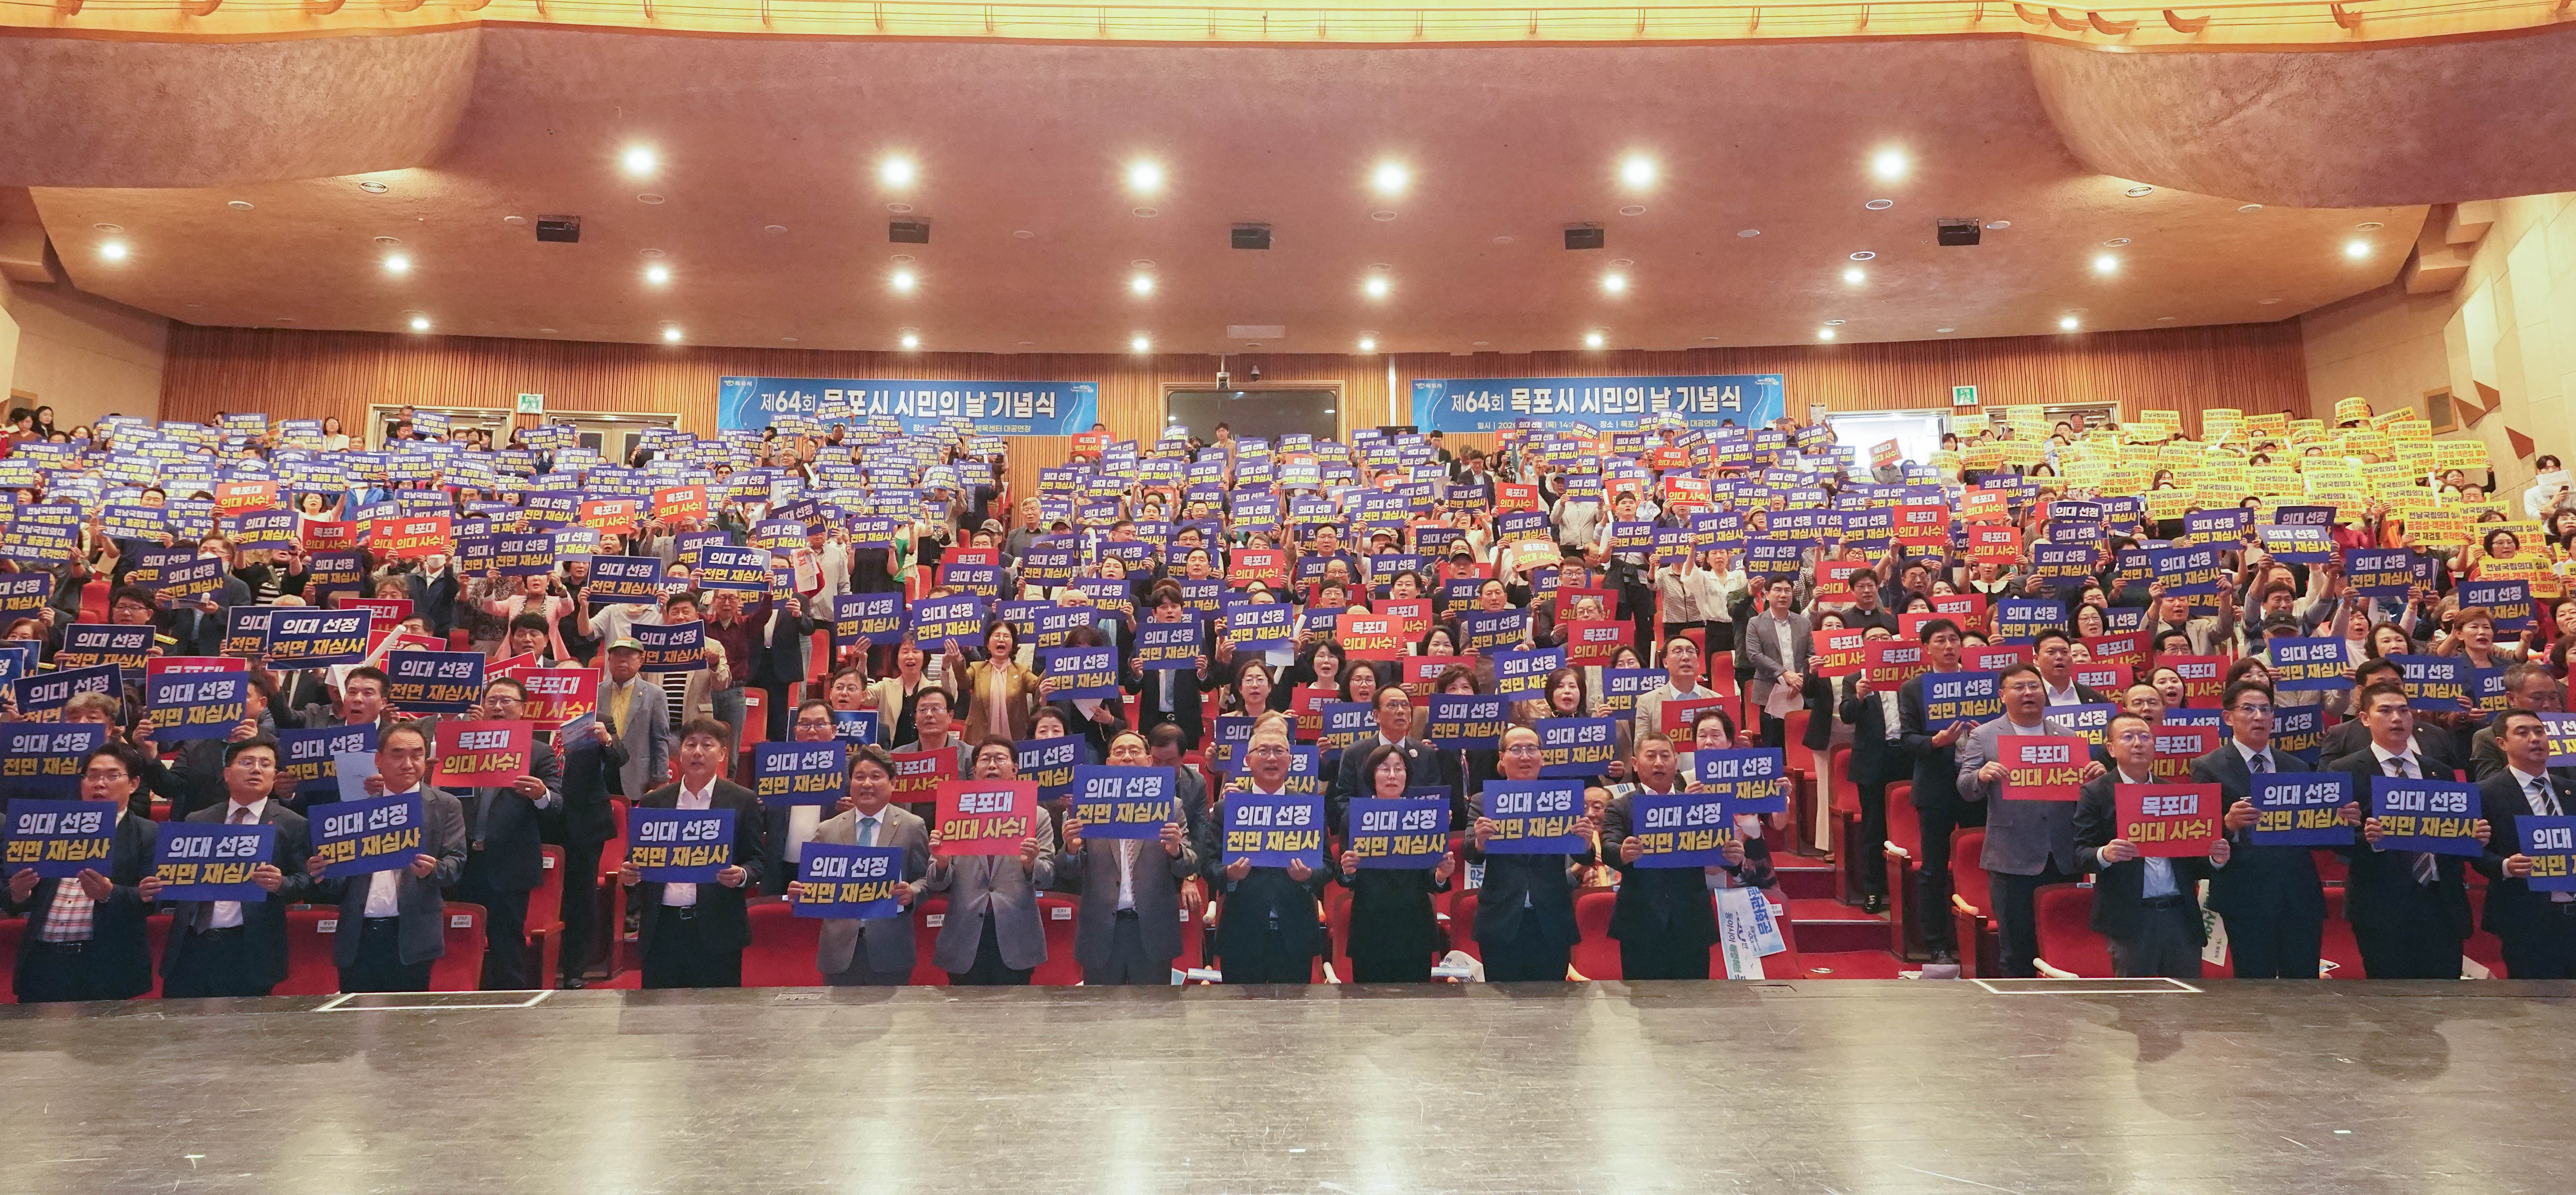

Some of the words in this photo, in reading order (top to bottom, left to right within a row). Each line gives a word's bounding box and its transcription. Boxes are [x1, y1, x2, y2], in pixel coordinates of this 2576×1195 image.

[761, 391, 815, 412] 제64회
[895, 390, 959, 417] 시민의
[965, 391, 987, 418] 날
[991, 391, 1055, 418] 기념식
[1451, 391, 1504, 412] 제64회
[1511, 387, 1575, 414] 목포시
[1580, 386, 1644, 414] 시민의
[1650, 386, 1671, 413] 날
[1676, 385, 1742, 413] 기념식
[1545, 421, 1557, 430] (목)
[1600, 420, 1614, 428] 장소
[1690, 419, 1718, 427] 대공연장
[1043, 472, 1058, 481] 의대
[1059, 472, 1073, 481] 선정
[1908, 468, 1922, 476] 의대
[1923, 468, 1937, 476] 선정
[2362, 465, 2396, 474] 전남국립의대
[1040, 481, 1054, 490] 전면
[1055, 481, 1075, 490] 재심사
[1568, 479, 1583, 488] 의대
[1583, 479, 1597, 487] 선정
[1906, 477, 1920, 486] 전면
[1581, 488, 1601, 497] 재심사
[115, 508, 158, 519] 전남국립의대
[15, 524, 67, 536] 전남국립의대
[149, 520, 164, 530] 심사
[2267, 529, 2294, 539] 의대
[2294, 529, 2320, 539] 선정
[2407, 521, 2452, 530] 공정성·객관성
[55, 538, 72, 548] 심사
[1982, 532, 2010, 543] 목포대
[2267, 541, 2292, 553] 전면
[2294, 541, 2332, 552] 재심사
[1974, 545, 1994, 557] 의대
[1996, 544, 2019, 556] 사수!
[841, 602, 865, 618] 의대
[867, 599, 893, 615] 선정
[1234, 612, 1259, 626] 의대
[1261, 609, 1285, 624] 선정
[280, 618, 320, 634] 의대
[321, 618, 361, 633] 선정
[837, 620, 859, 637] 전면
[861, 617, 900, 633] 재심사
[1228, 628, 1253, 643] 전면
[1256, 625, 1291, 640] 재심사
[1352, 621, 1387, 634] 목포대
[272, 641, 308, 657] 전면
[312, 637, 366, 654] 재심사
[1342, 637, 1367, 650] 의대
[1368, 636, 1397, 650] 사수!
[2281, 647, 2308, 662] 의대
[2310, 644, 2337, 660] 선정
[398, 660, 435, 677] 의대
[438, 662, 474, 679] 선정
[2276, 665, 2304, 681] 전면
[2307, 662, 2349, 678] 재심사
[390, 684, 426, 700] 전면
[428, 685, 479, 701] 재심사
[459, 730, 510, 750] 목포대
[442, 755, 477, 773] 의대
[479, 753, 521, 771] 사수!
[2020, 745, 2069, 764] 목포대
[2010, 768, 2042, 787] 의대
[2046, 767, 2085, 785] 사수!
[1085, 778, 1122, 798] 의대
[1126, 776, 1162, 797] 선정
[959, 791, 1013, 814] 목포대
[2142, 794, 2198, 817] 목포대
[2386, 790, 2426, 811] 의대
[2430, 792, 2467, 813] 선정
[16, 813, 58, 835] 의대
[60, 811, 102, 834] 선정
[324, 813, 363, 838] 의대
[368, 803, 408, 830] 선정
[1077, 804, 1112, 824] 전면
[1116, 803, 1170, 822] 재심사
[1235, 806, 1272, 826] 의대
[1275, 805, 1311, 826] 선정
[1645, 806, 1682, 828] 의대
[1686, 803, 1721, 825] 선정
[640, 821, 679, 841] 의대
[682, 819, 721, 841] 선정
[943, 819, 979, 840] 의대
[983, 817, 1026, 838] 사수!
[2127, 822, 2166, 842] 의대
[2170, 819, 2212, 840] 사수!
[2379, 816, 2416, 836] 전면
[2420, 817, 2480, 838] 재심사
[6, 841, 43, 862] 전면
[45, 838, 110, 860] 재심사
[318, 840, 355, 864] 전면
[361, 828, 420, 856] 재심사
[1227, 831, 1262, 851] 전면
[1266, 831, 1320, 851] 재심사
[1639, 833, 1673, 854] 전면
[1678, 828, 1731, 851] 재심사
[632, 847, 667, 867] 전면
[671, 845, 729, 866] 재심사
[1725, 911, 1736, 943] 동아시아
